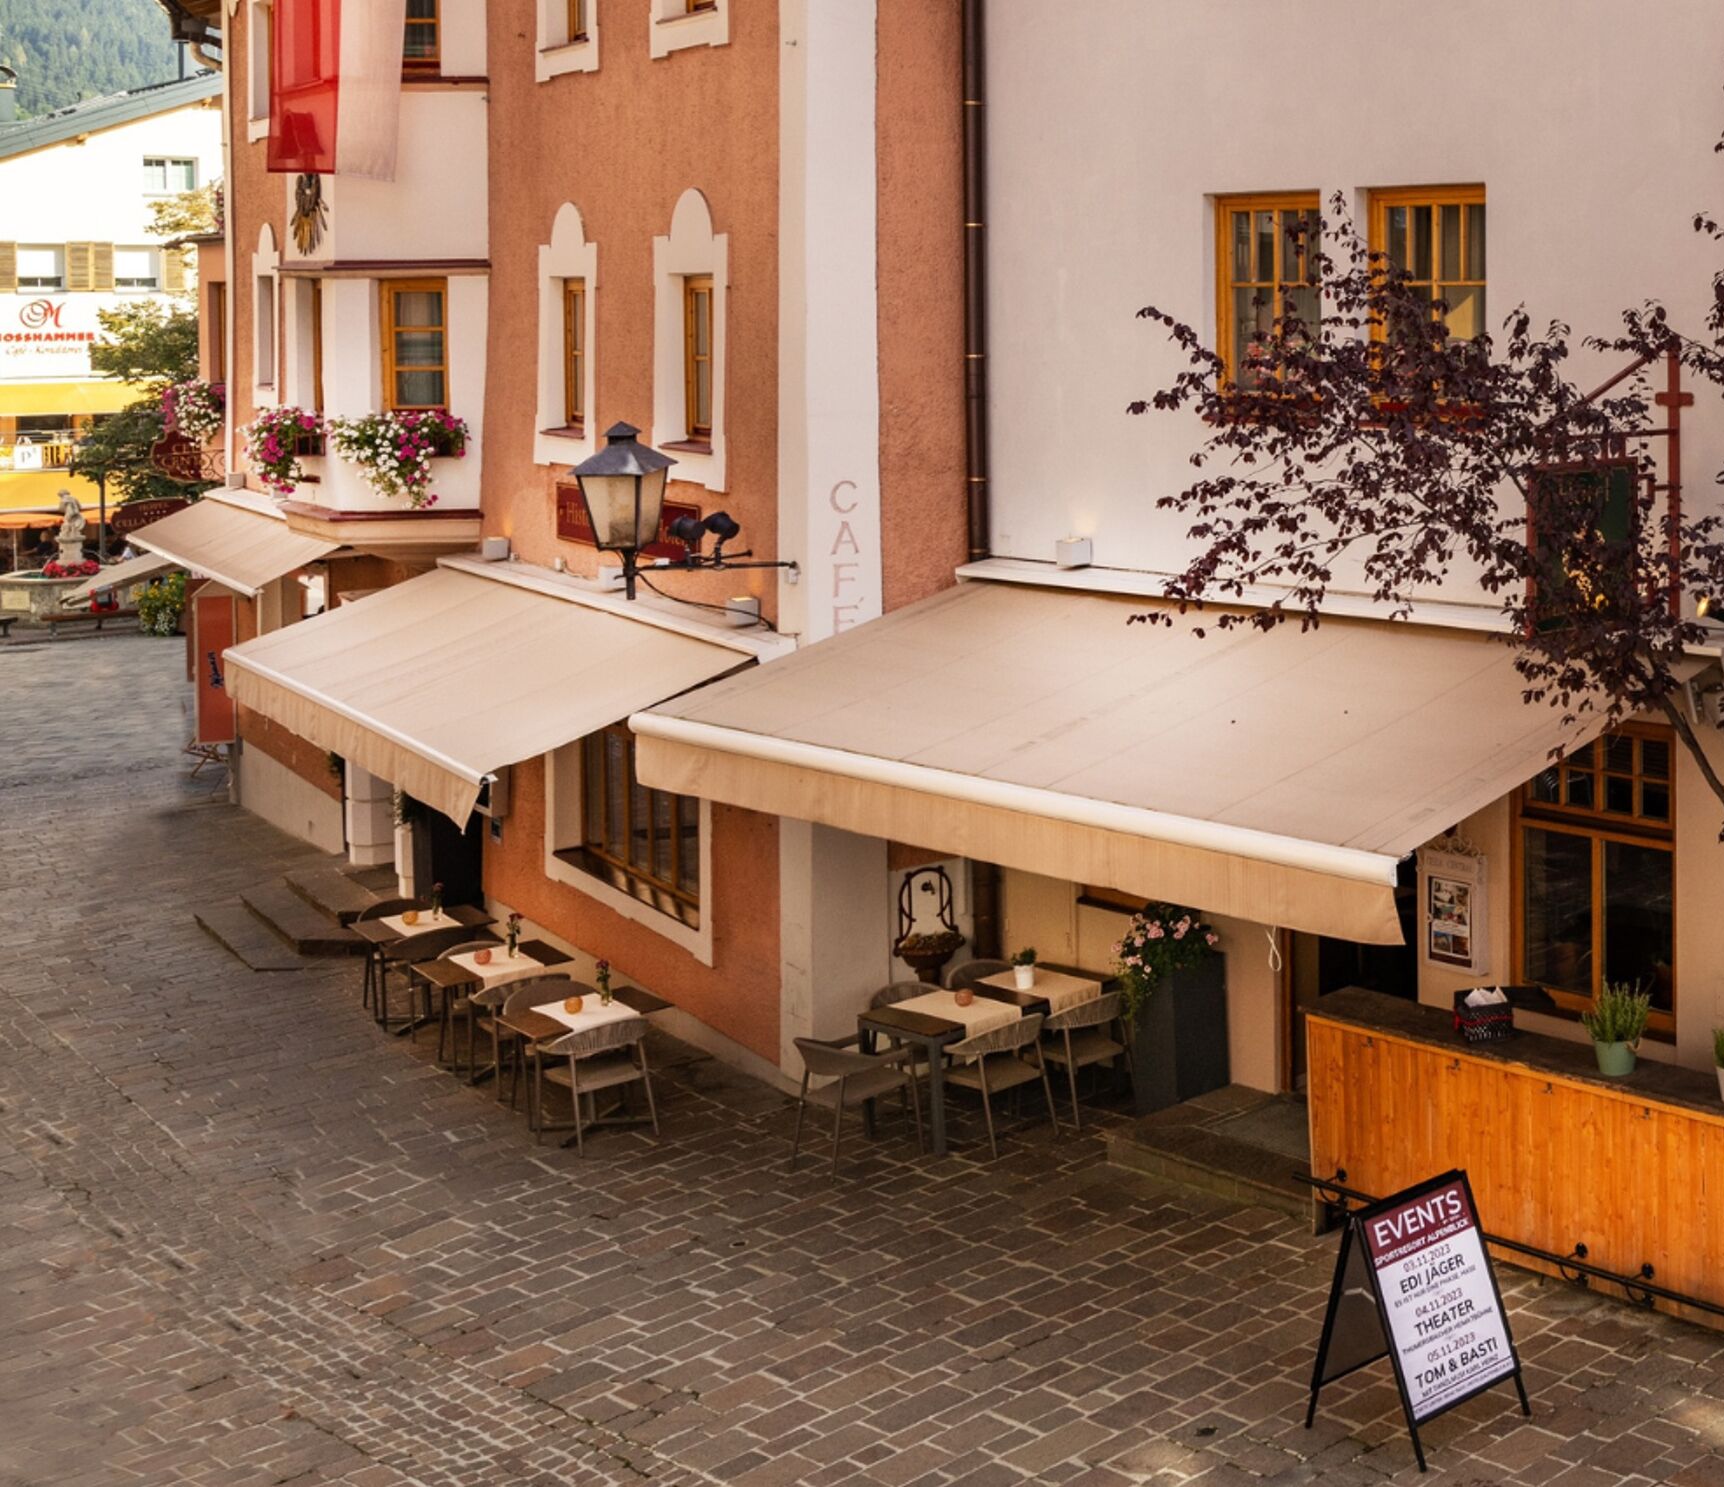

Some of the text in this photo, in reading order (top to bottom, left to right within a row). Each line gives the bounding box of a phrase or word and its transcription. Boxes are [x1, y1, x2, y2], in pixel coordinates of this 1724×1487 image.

[0, 332, 95, 342] OSSHAMMER
[1373, 1190, 1461, 1248] EVENTS
[1399, 1253, 1465, 1294] EDI JÄGER
[1403, 1243, 1451, 1273] 03.11.2023
[1414, 1299, 1475, 1336] THEATER
[1415, 1287, 1463, 1318] 04.11.2023
[1415, 1363, 1446, 1388] TOM
[1448, 1358, 1458, 1372] &
[1460, 1336, 1499, 1366] BASTI
[1427, 1332, 1476, 1363] 05.11.2023
